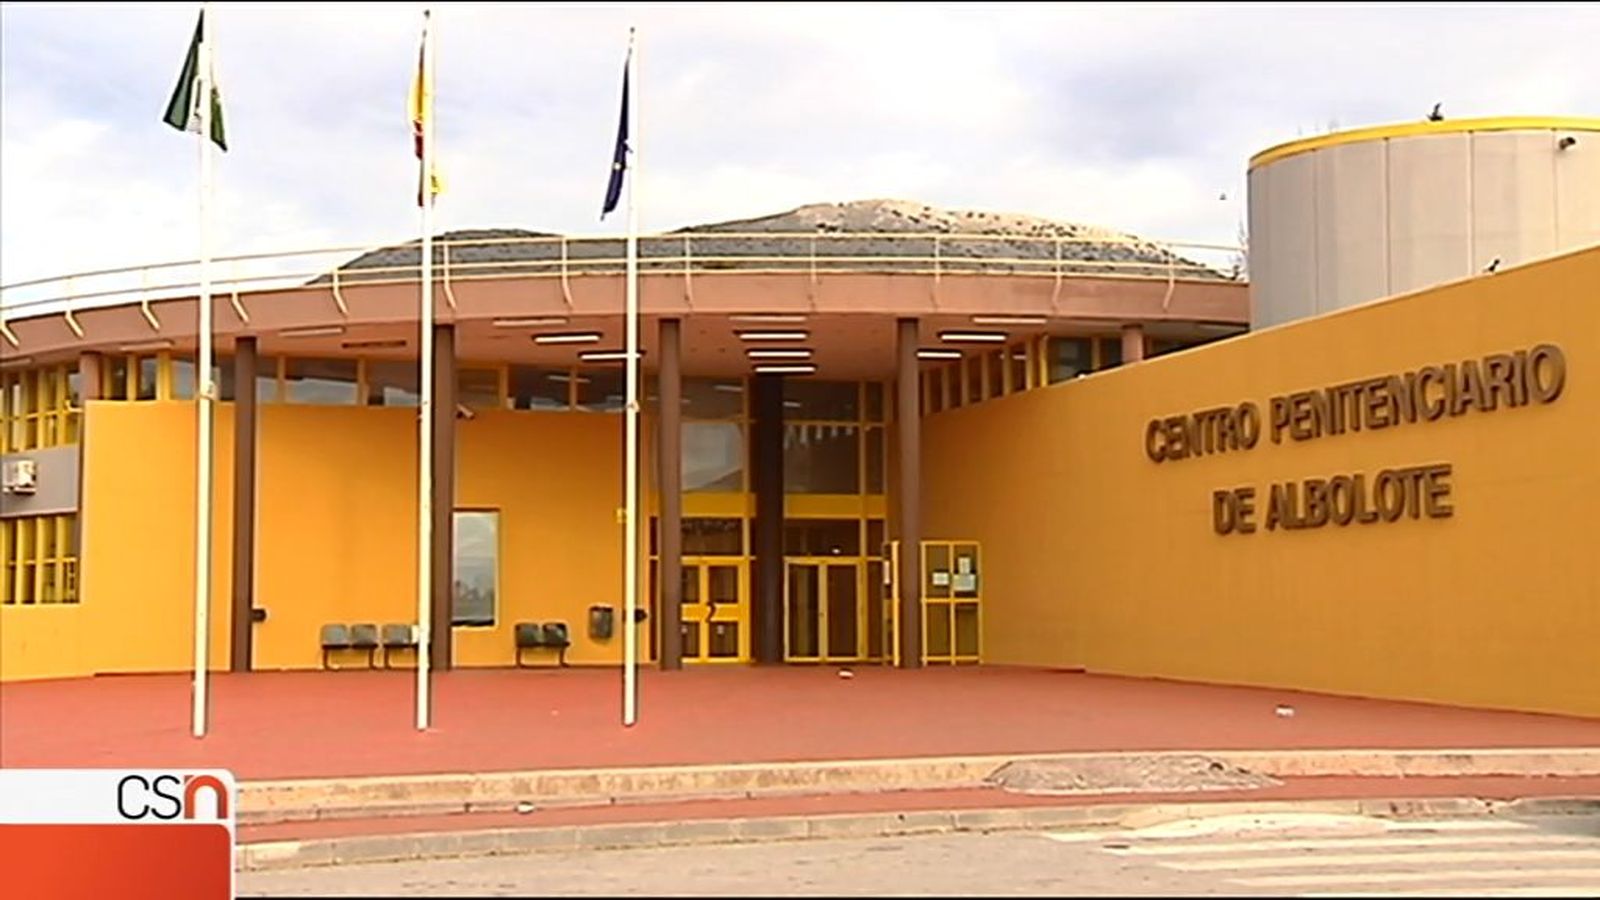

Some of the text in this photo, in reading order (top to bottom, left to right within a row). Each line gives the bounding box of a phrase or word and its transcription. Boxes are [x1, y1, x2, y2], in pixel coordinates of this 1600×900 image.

[1145, 344, 1567, 463] CENTRO PENITENCIARIO
[1212, 463, 1454, 536] DE ALBOLOTE
